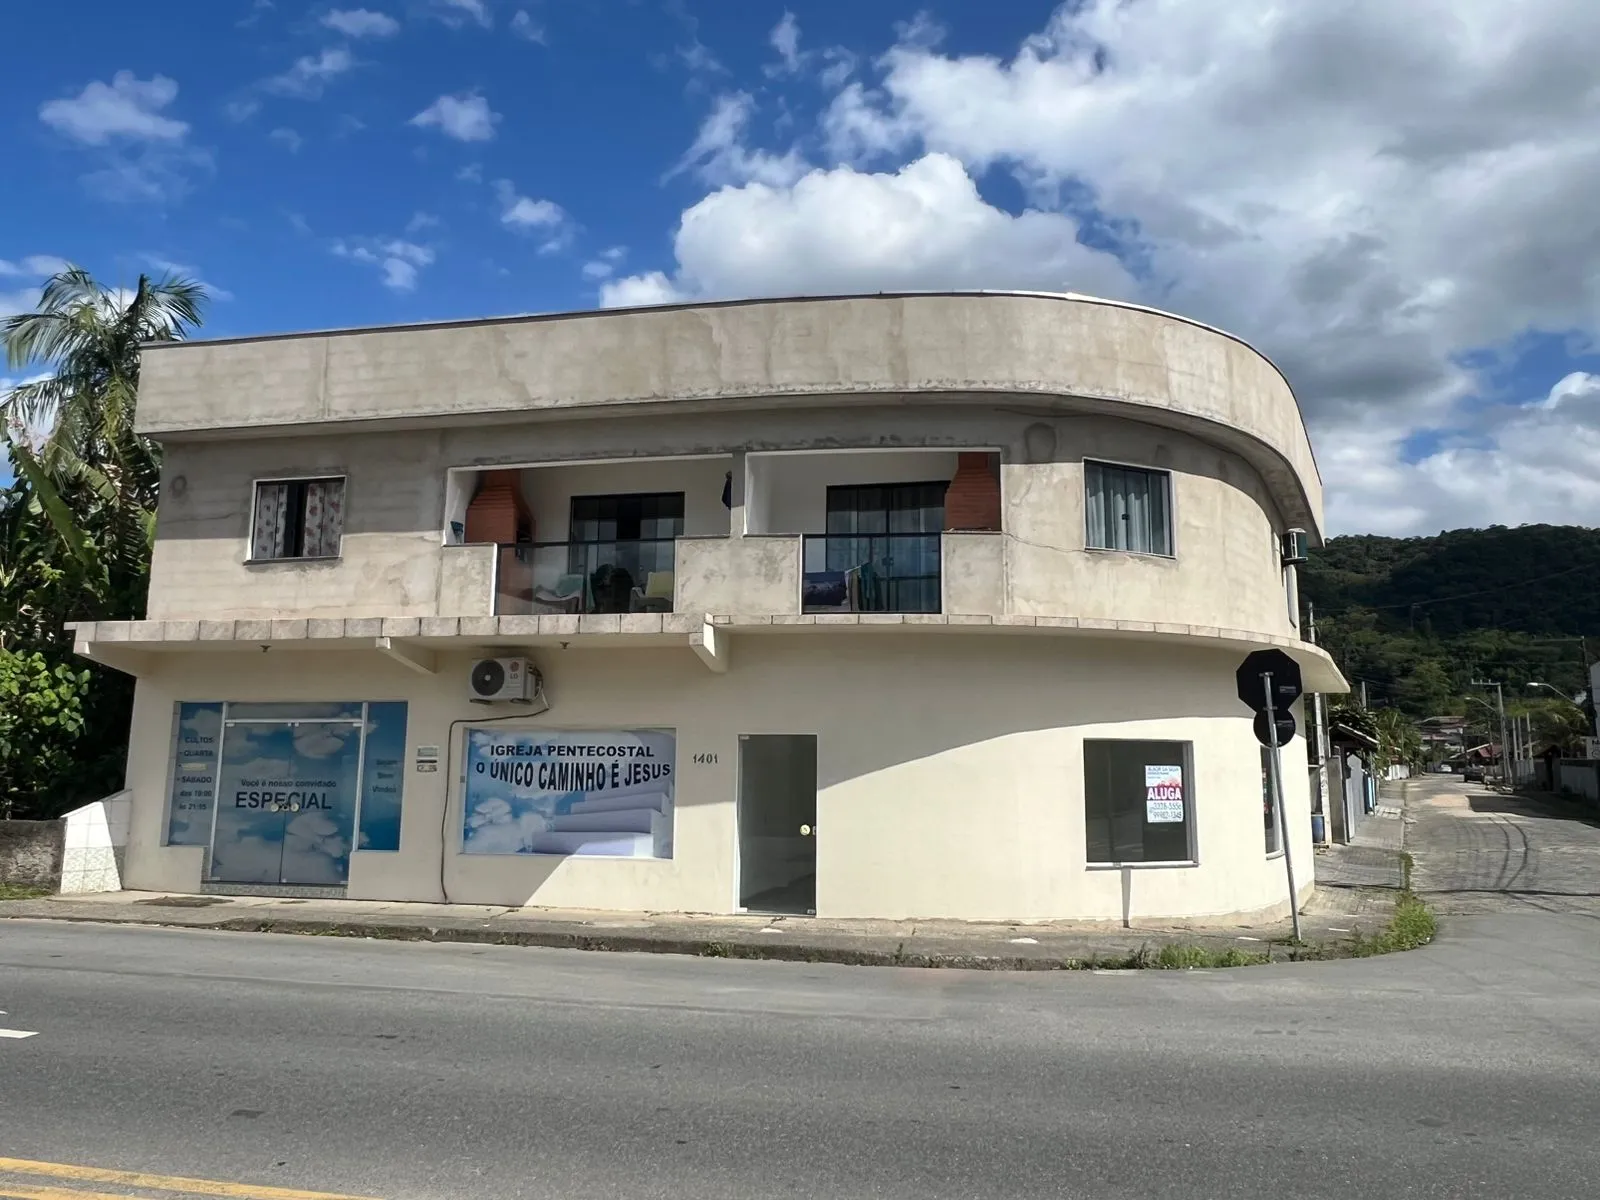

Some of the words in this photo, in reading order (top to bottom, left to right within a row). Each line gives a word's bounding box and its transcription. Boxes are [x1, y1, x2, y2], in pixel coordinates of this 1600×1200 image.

[490, 745, 543, 757] IGREJA
[547, 745, 655, 758] PENTECOSTAL
[692, 753, 719, 764] 1401
[476, 762, 485, 774] O
[490, 758, 534, 787] ÚNICO
[538, 762, 606, 792] CAMINHO
[611, 760, 620, 789] É
[624, 763, 671, 786] JESUS
[294, 778, 337, 788] convidado
[1147, 787, 1182, 800] ALUGA
[235, 791, 333, 810] ESPECIAL
